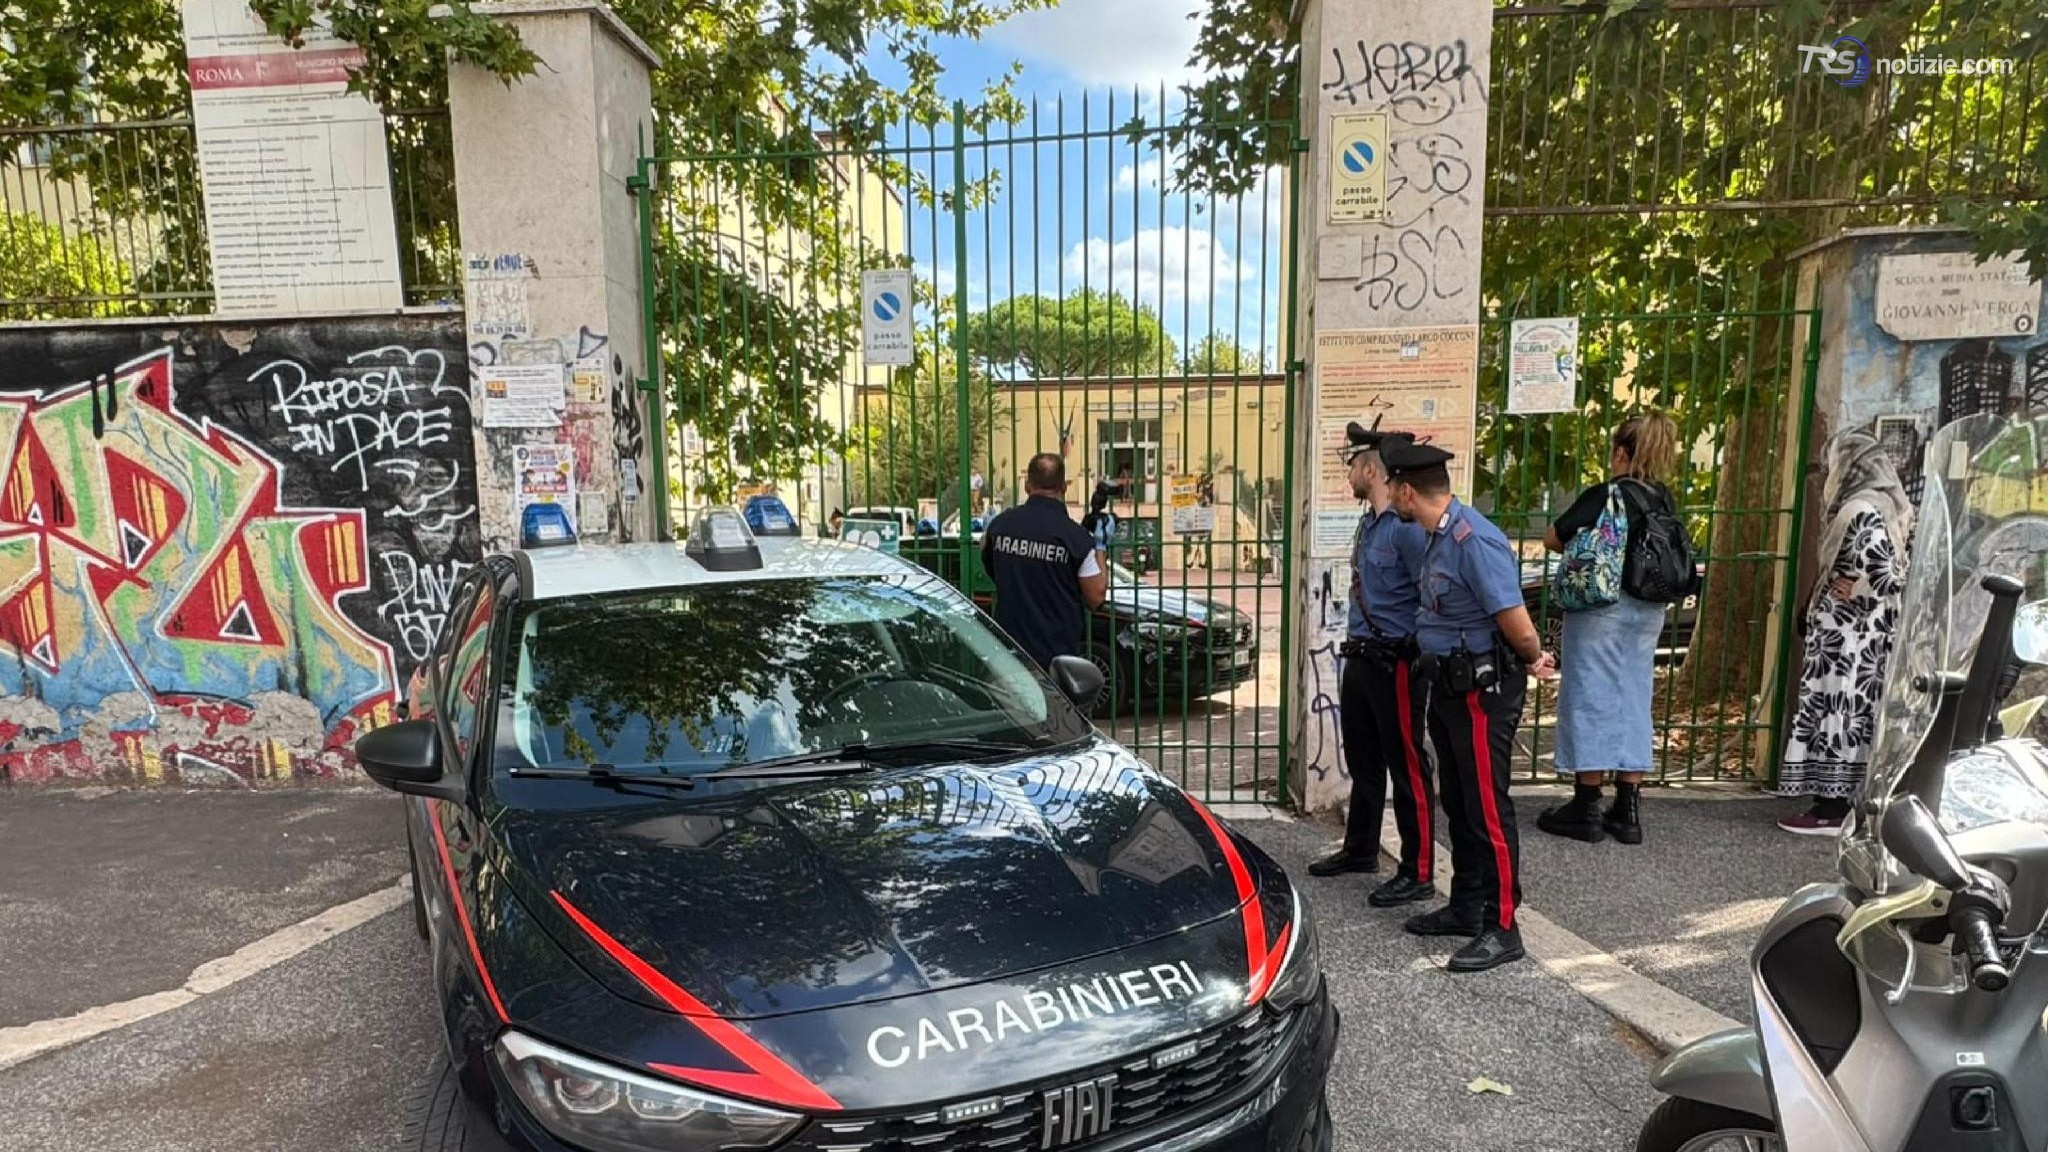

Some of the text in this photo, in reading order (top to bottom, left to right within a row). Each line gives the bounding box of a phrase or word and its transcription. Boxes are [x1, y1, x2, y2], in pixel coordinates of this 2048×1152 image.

[196, 67, 244, 83] ROMA
[1335, 196, 1378, 206] carrabile
[1343, 186, 1372, 196] passo
[1894, 275, 1935, 286] SCUOLA
[1941, 273, 1974, 284] MEDIA
[1882, 300, 2032, 320] GIOVANNI VERGA
[873, 333, 902, 341] passo
[247, 359, 418, 424] RIPOSA
[288, 419, 336, 456] IN
[331, 407, 453, 491] PACE
[992, 535, 1070, 564] ARABINIERI
[866, 959, 1205, 1069] CARABINIERI
[1041, 1073, 1119, 1150] FIAT
